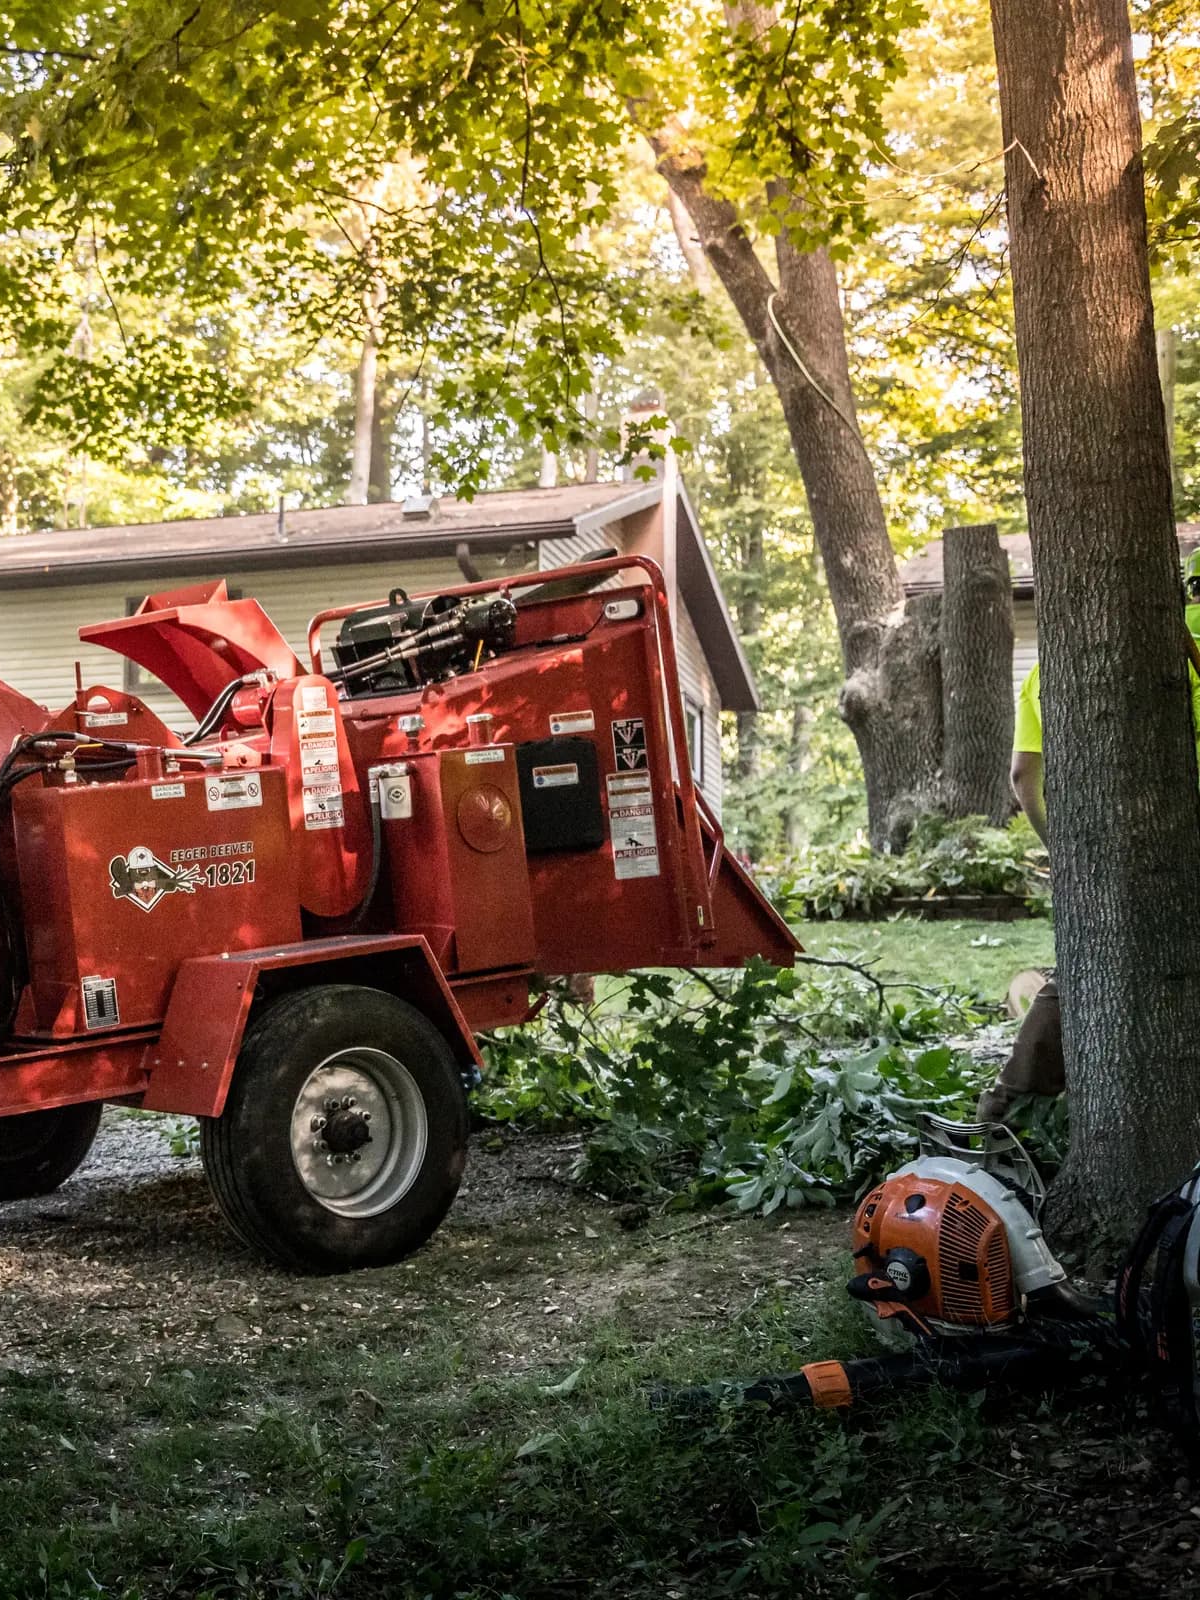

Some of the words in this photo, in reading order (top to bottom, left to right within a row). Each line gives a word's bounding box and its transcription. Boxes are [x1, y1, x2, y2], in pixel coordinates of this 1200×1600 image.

[620, 807, 651, 817] DANGER
[170, 847, 207, 862] EEGER
[210, 842, 253, 857] BEEVER
[624, 848, 656, 857] PELIGRO
[205, 860, 255, 887] 1821
